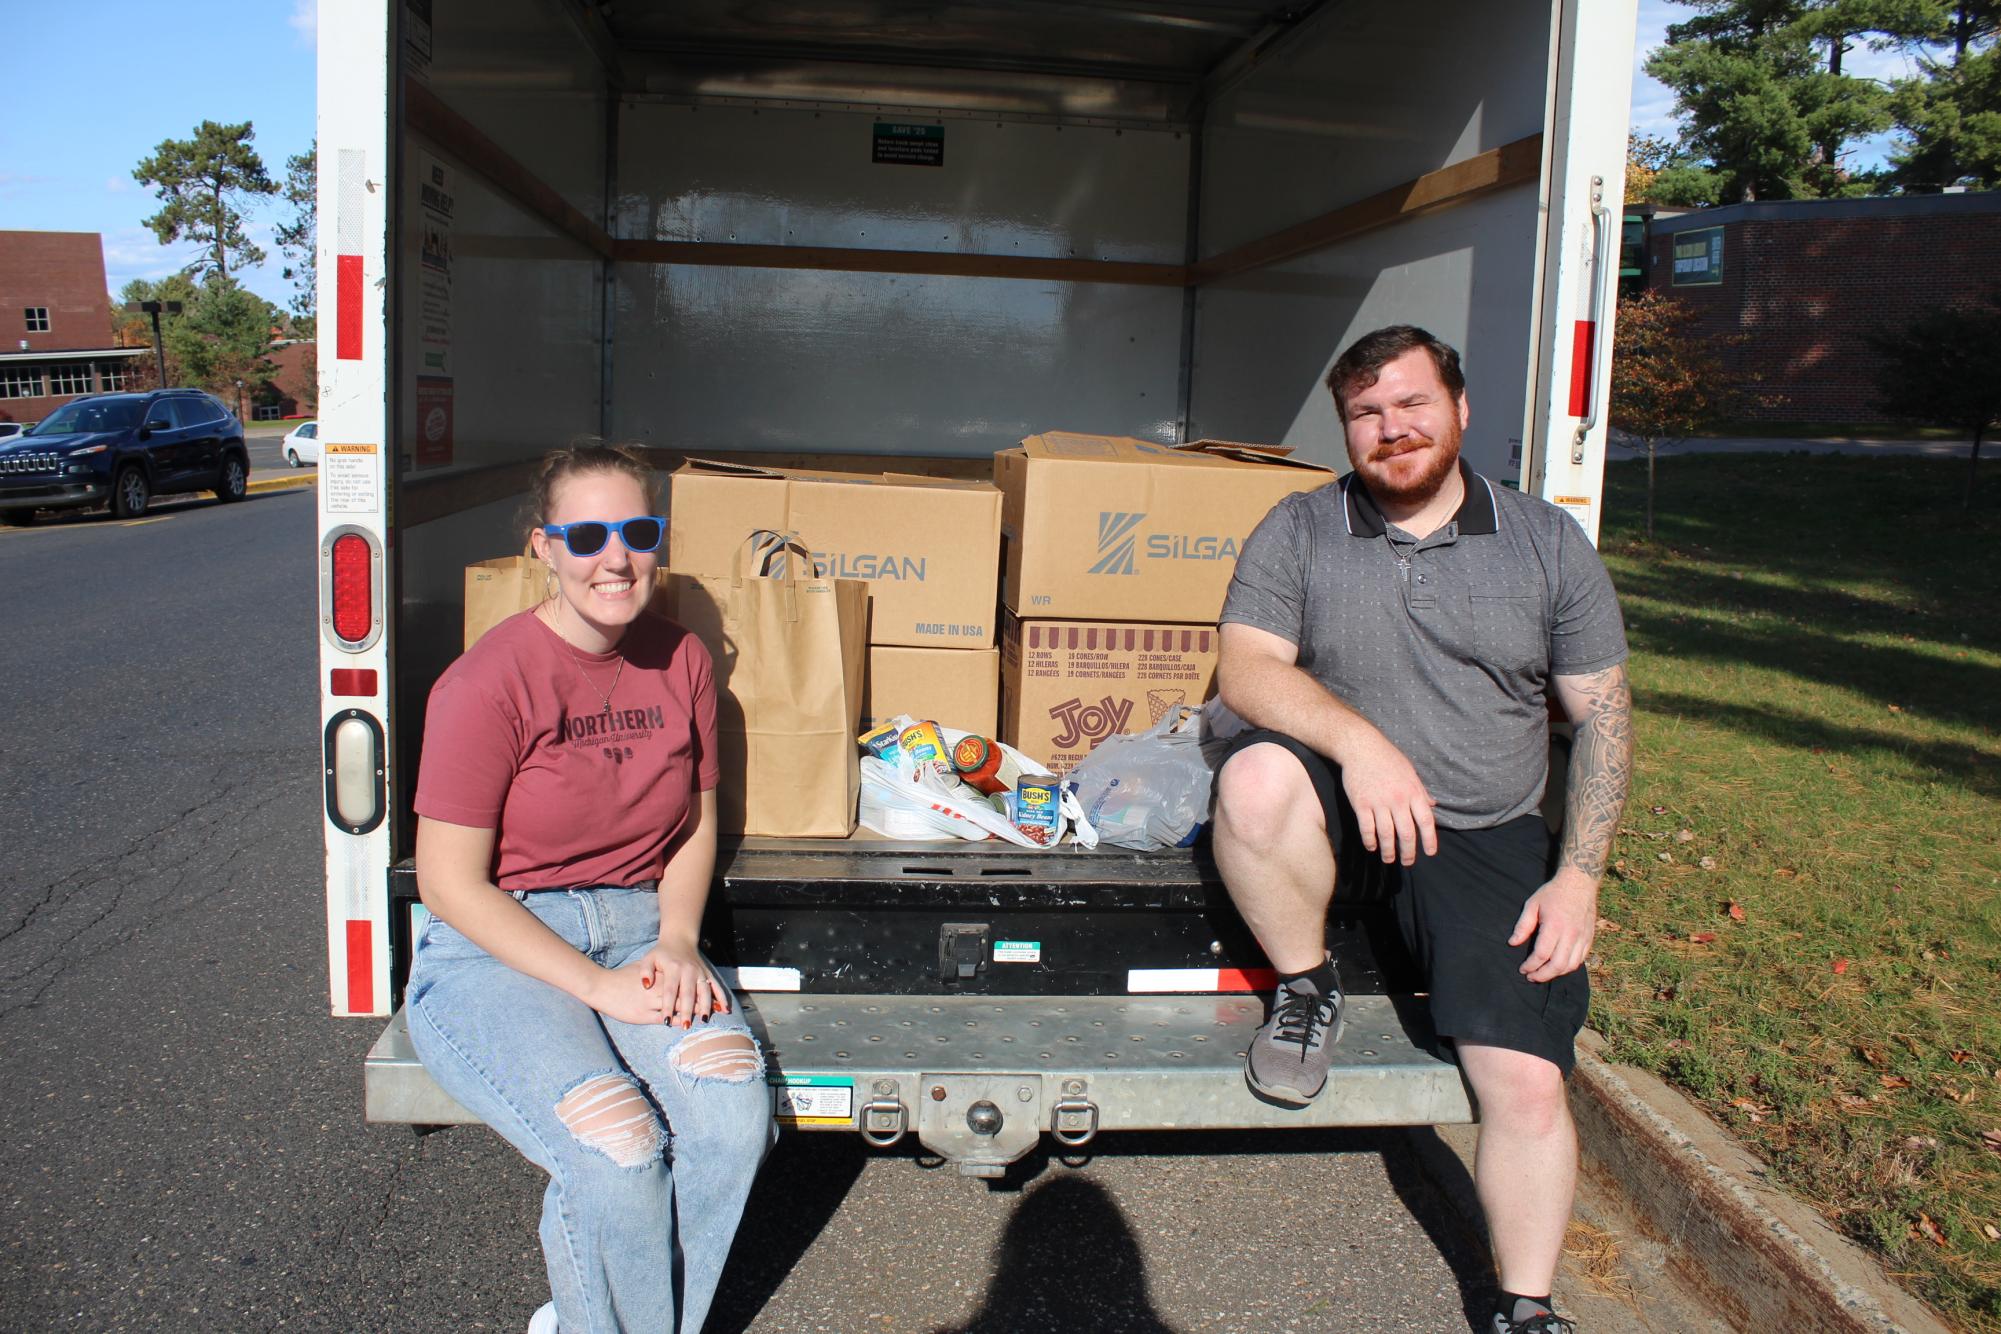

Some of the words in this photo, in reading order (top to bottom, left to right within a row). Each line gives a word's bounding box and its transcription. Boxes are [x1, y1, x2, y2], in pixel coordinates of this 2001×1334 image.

[1147, 534, 1247, 560] SILGA
[1031, 595, 1051, 606] WR
[915, 623, 945, 635] MADE
[948, 624, 960, 635] IN
[962, 625, 983, 637] USA
[1028, 660, 1035, 668] 12
[1035, 660, 1058, 668] HILERAS
[1028, 669, 1034, 677] 12
[1173, 672, 1184, 680] PAR
[563, 705, 665, 741] NORTHERN
[572, 736, 610, 749] Michigan
[611, 729, 653, 743] University
[1023, 790, 1050, 802] BUSH'S
[1019, 811, 1035, 820] Kidney
